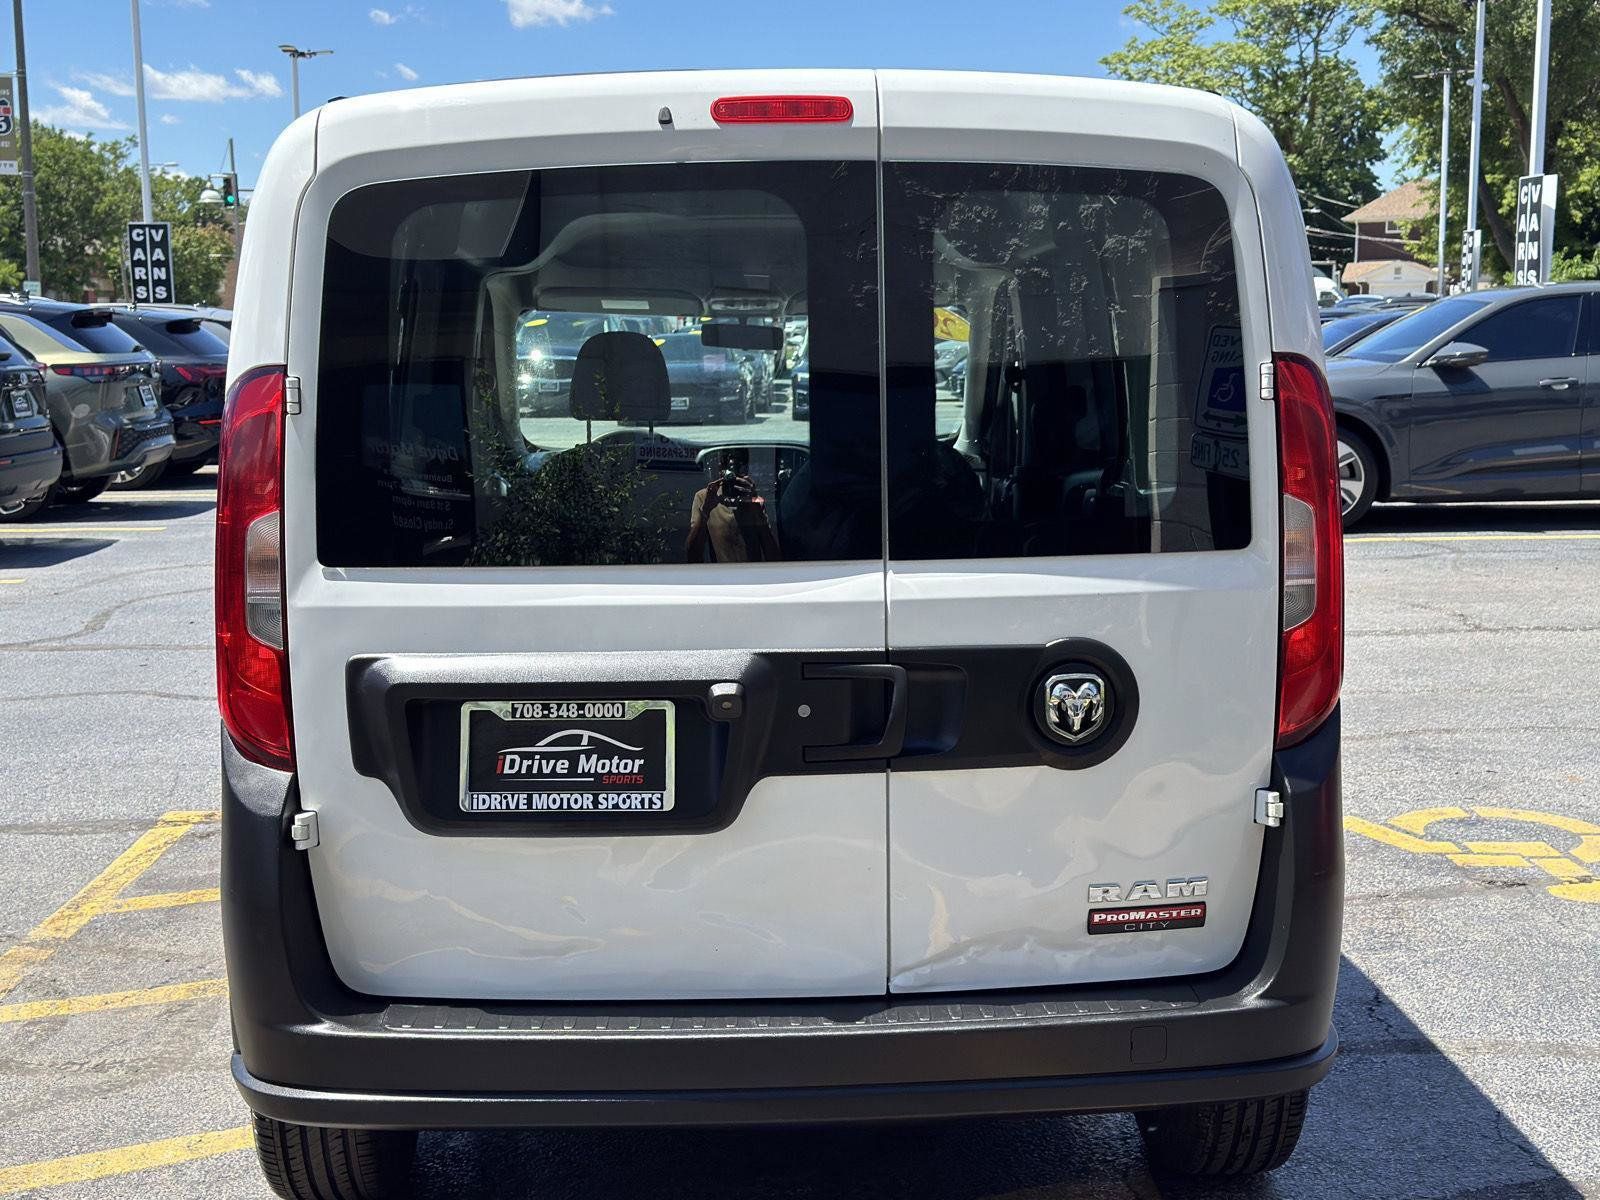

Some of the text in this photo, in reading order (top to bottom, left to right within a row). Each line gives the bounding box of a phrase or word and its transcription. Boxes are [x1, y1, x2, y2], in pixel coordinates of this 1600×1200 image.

[1516, 185, 1529, 286] CARS
[1527, 184, 1541, 285] VANS
[131, 228, 148, 299] CARS
[150, 228, 167, 300] VANS
[513, 703, 623, 719] 708-348-0000
[496, 754, 644, 774] iDrive Motor
[602, 775, 644, 784] SPORTS
[532, 793, 593, 810] MOTOR
[598, 793, 662, 810] SPORTS
[1088, 876, 1208, 903] RAM
[1124, 921, 1170, 931] CITY
